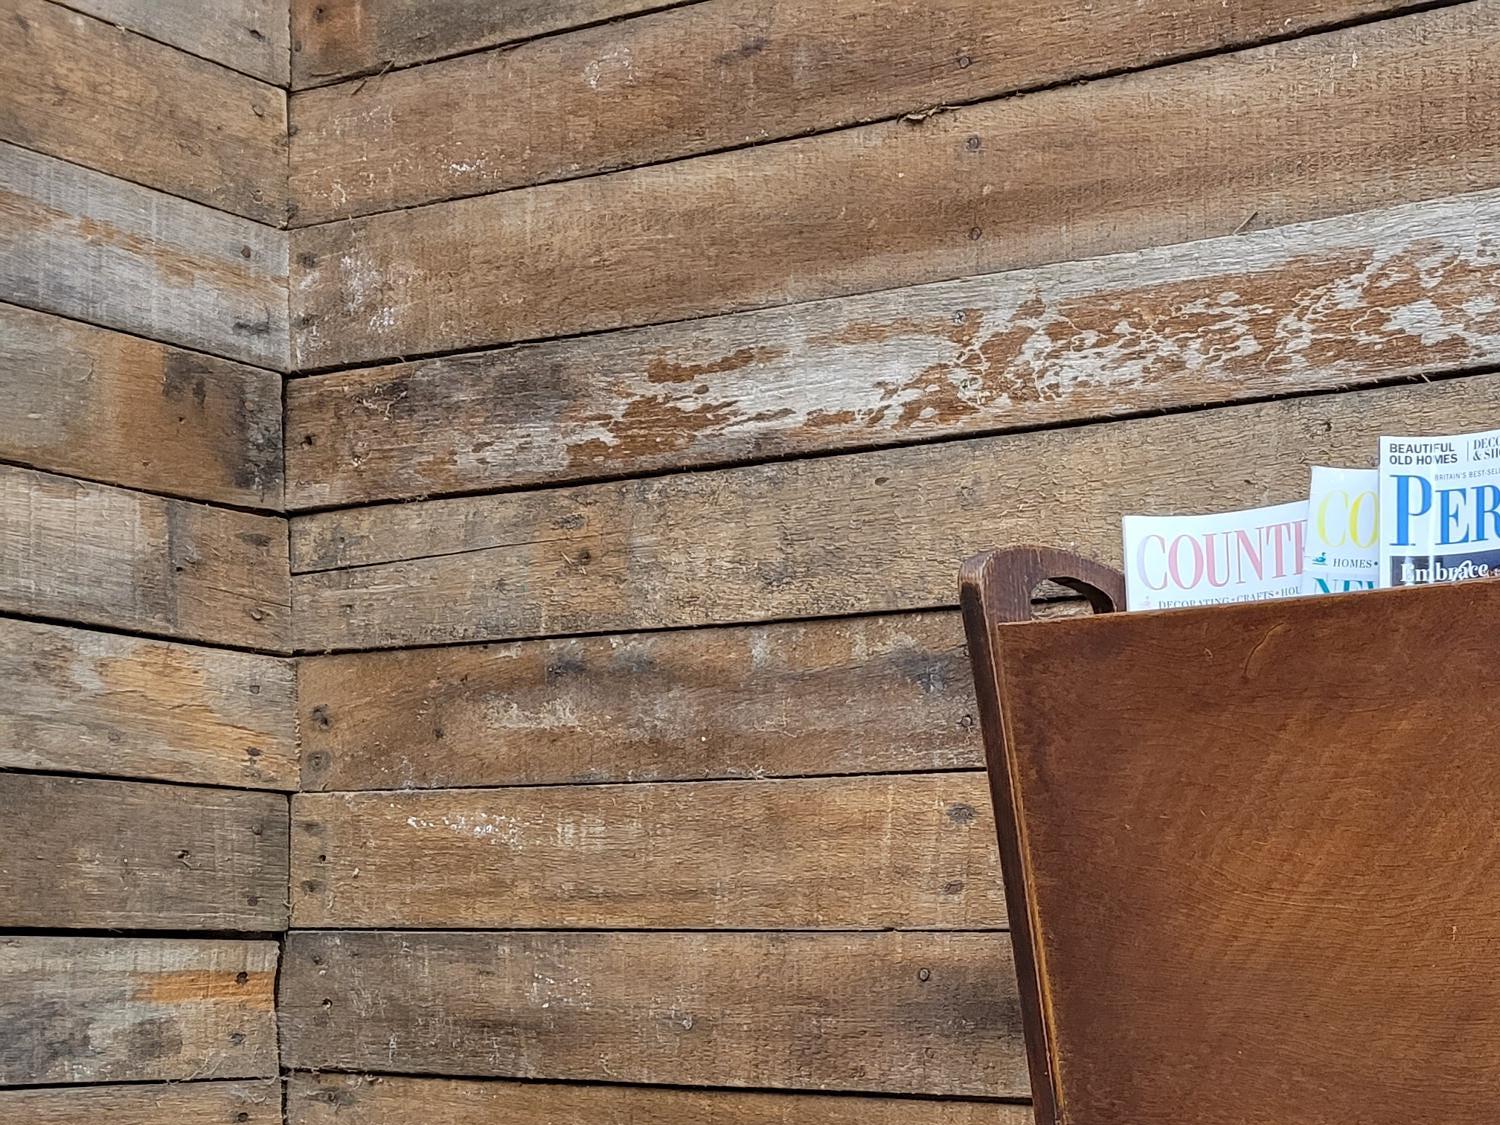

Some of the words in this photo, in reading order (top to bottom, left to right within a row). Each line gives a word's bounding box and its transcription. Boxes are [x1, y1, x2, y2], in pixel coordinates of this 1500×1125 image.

[1389, 443, 1455, 454] BEAUTIFUL
[1389, 454, 1414, 465] OLD
[1416, 453, 1458, 465] HOMES
[1472, 450, 1482, 461] &
[1435, 471, 1467, 481] BRITAIN'S
[1333, 558, 1372, 569] HOMES
[1400, 560, 1489, 584] Embrace
[1237, 591, 1275, 604] CRAFTS
